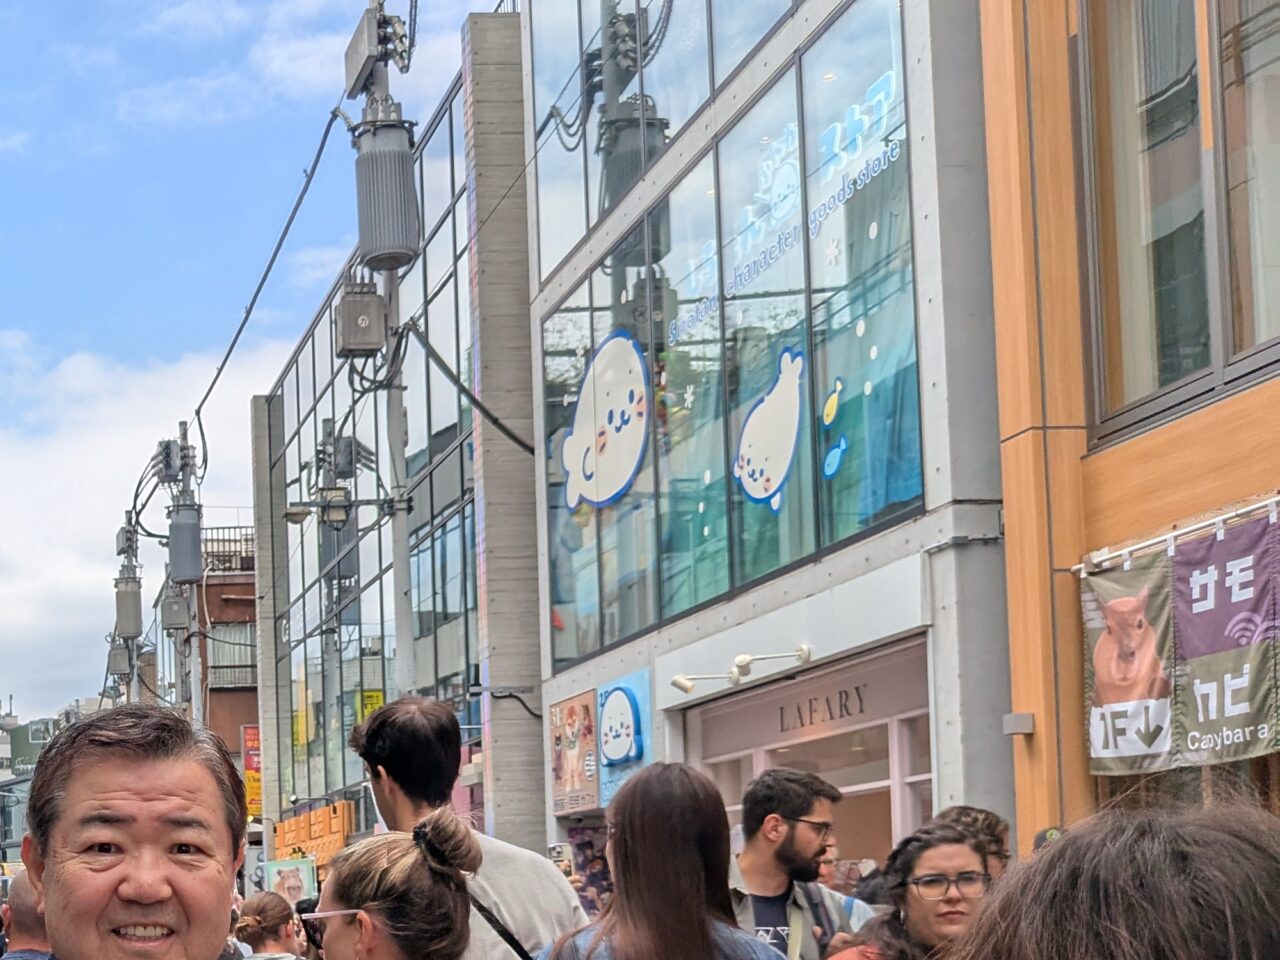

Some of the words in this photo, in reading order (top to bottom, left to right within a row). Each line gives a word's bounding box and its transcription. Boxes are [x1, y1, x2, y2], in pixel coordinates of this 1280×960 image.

[807, 172, 854, 238] goods
[855, 139, 900, 194] store
[778, 683, 869, 733] LAFARY
[1100, 710, 1128, 750] 1F
